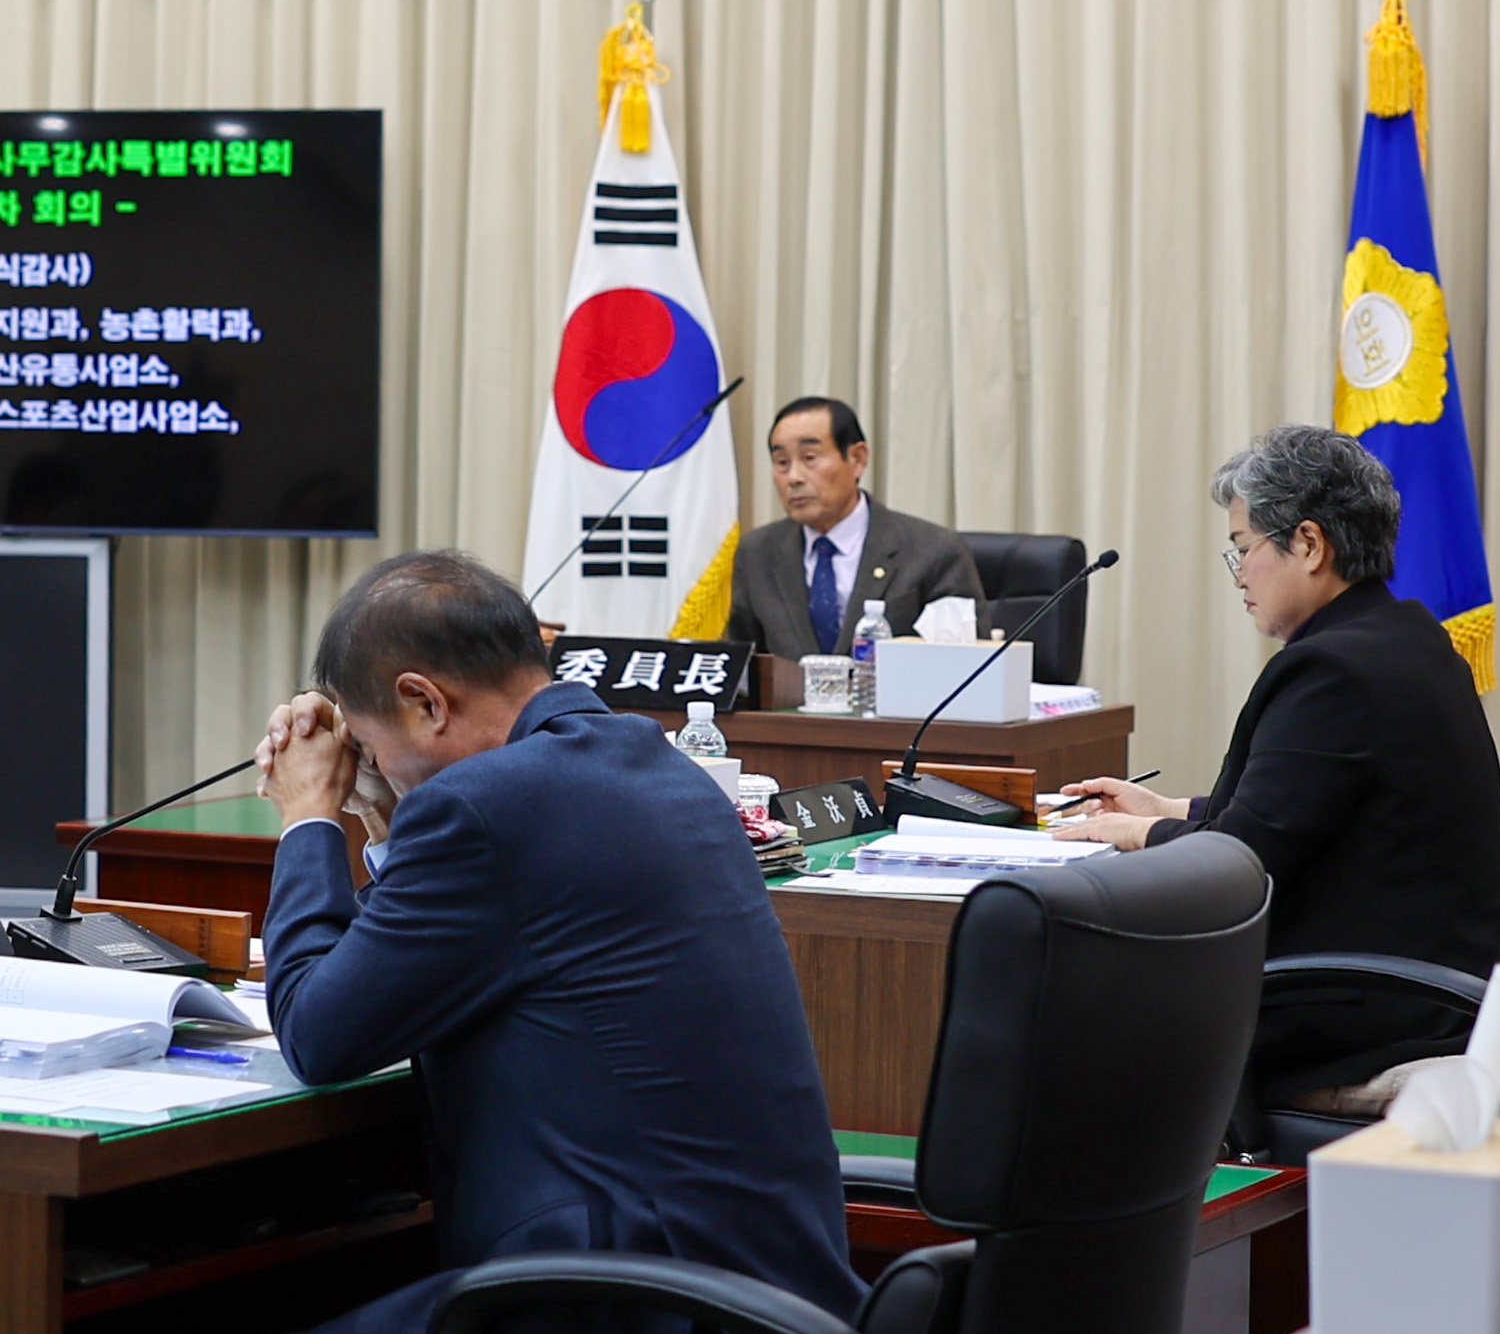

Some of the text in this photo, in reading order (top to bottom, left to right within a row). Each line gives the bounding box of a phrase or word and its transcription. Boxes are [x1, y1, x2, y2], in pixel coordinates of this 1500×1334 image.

[33, 189, 102, 227] 회의
[98, 306, 263, 343] 농촌활력과,
[552, 647, 731, 695] 委員長
